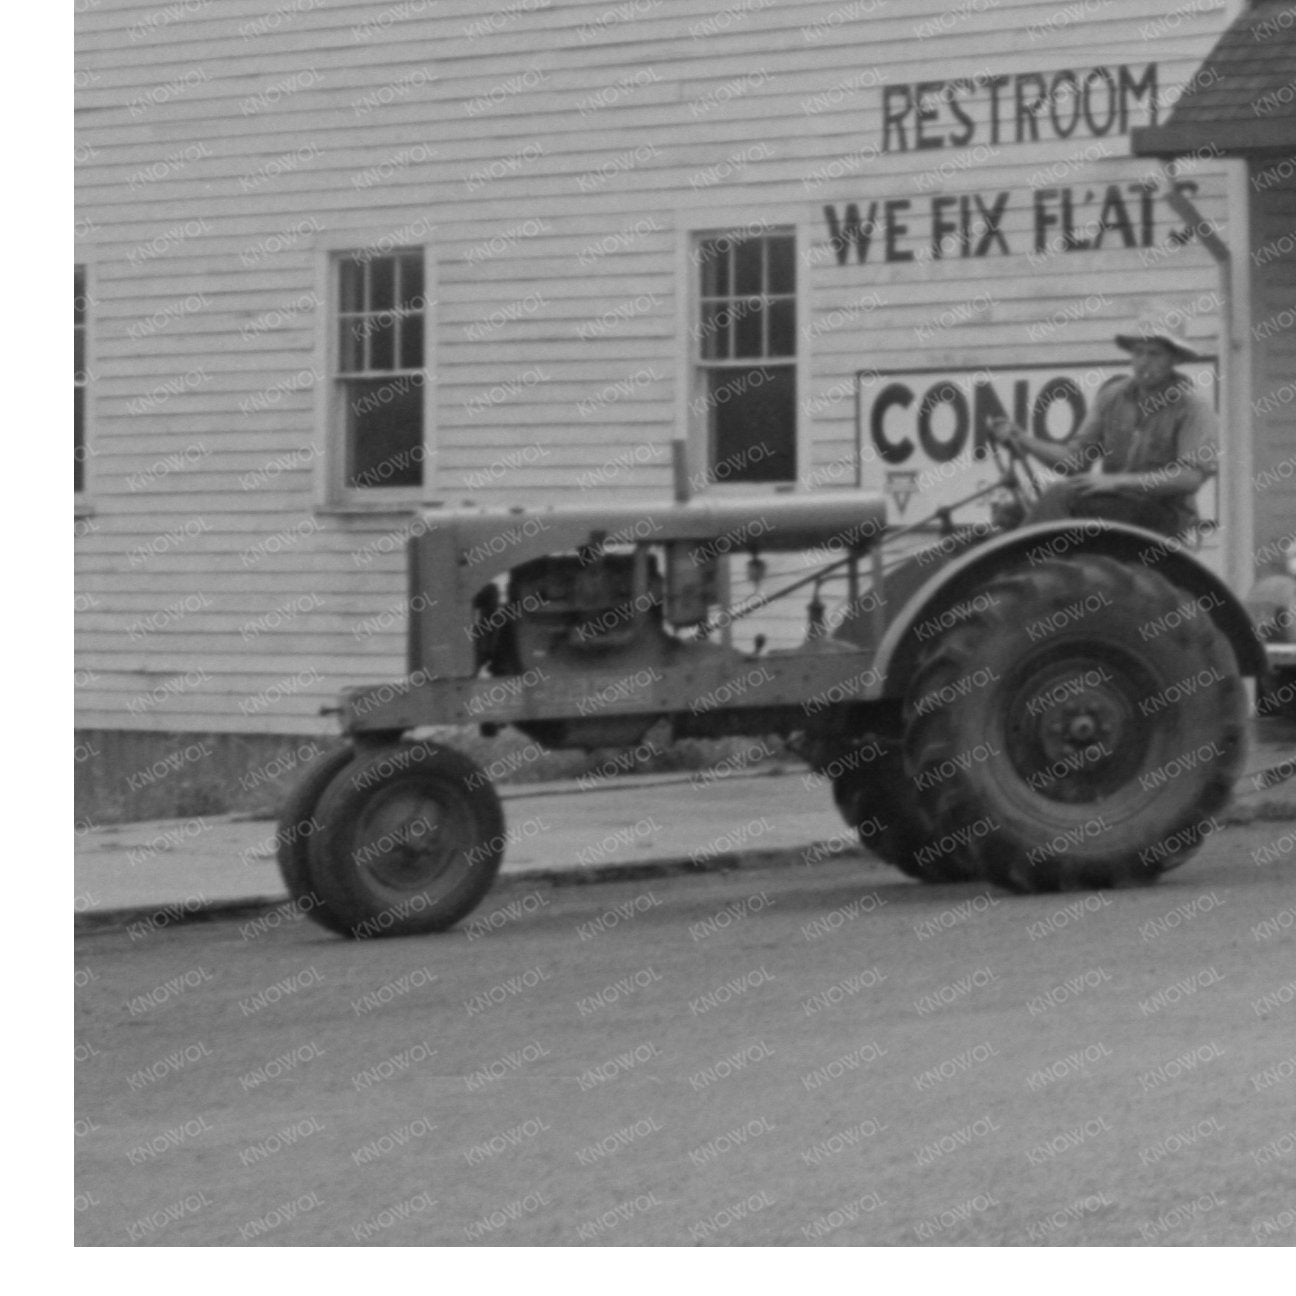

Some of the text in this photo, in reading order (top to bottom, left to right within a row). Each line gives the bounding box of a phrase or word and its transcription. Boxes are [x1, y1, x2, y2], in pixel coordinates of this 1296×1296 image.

[881, 61, 1158, 154] RESTROOM
[823, 180, 1200, 266] WE FIX FLATS
[870, 375, 1129, 465] CONO
